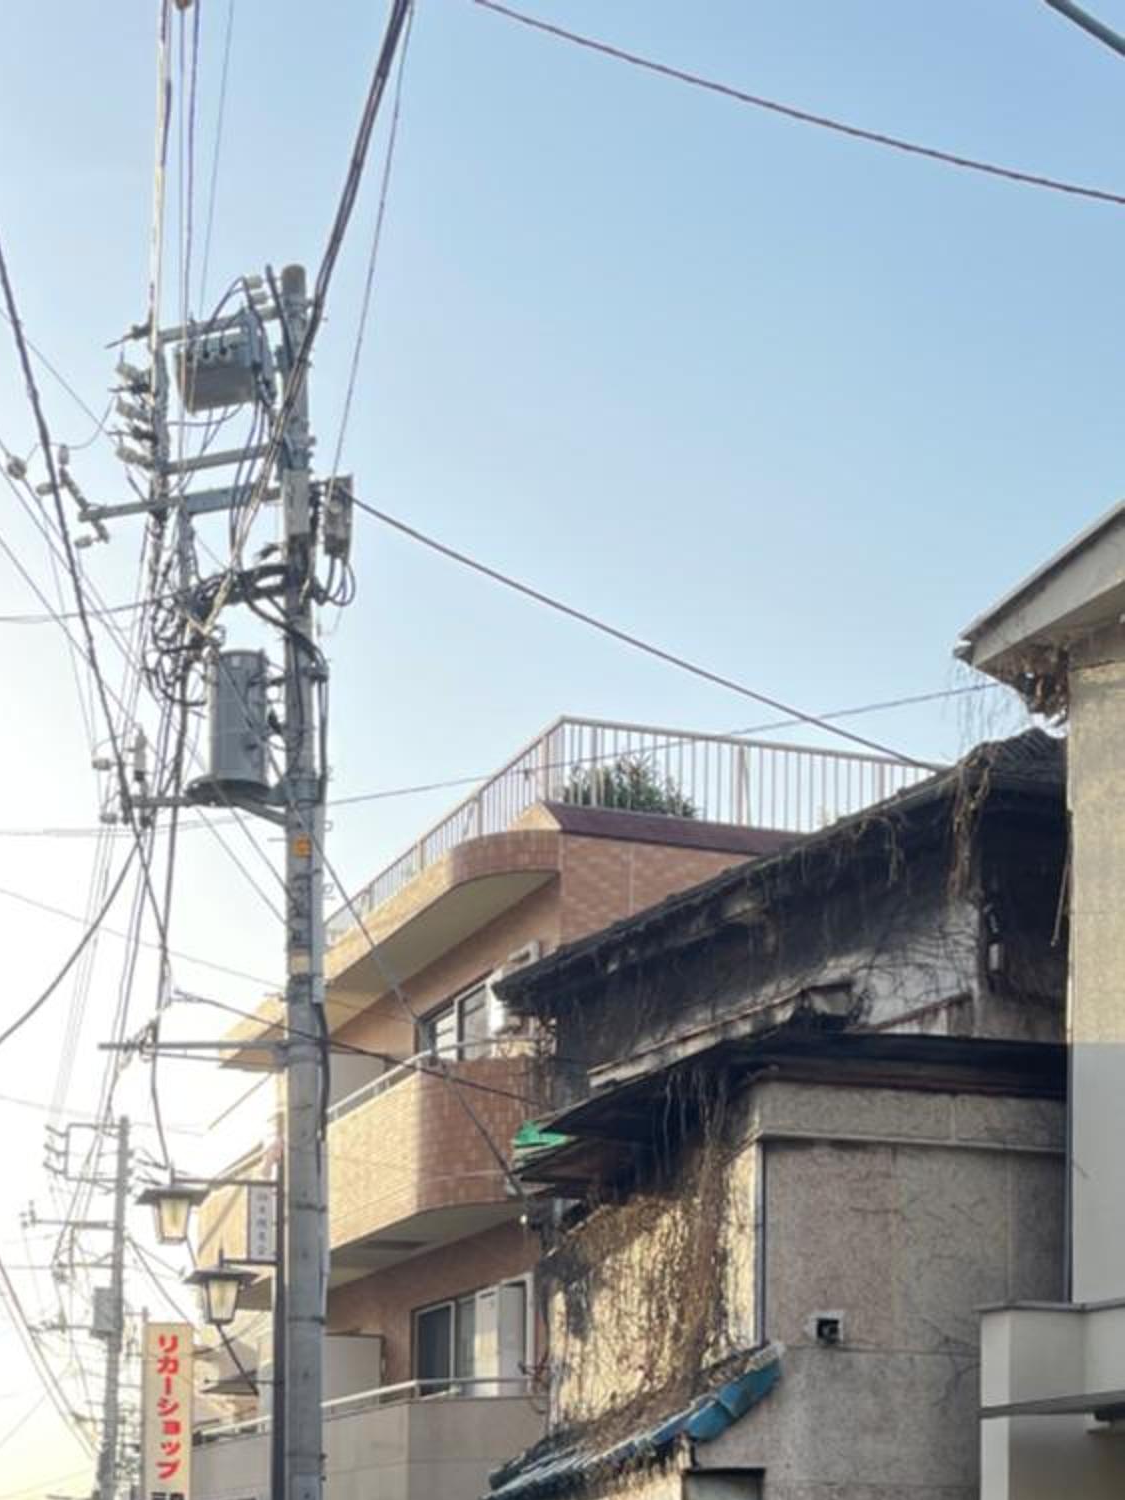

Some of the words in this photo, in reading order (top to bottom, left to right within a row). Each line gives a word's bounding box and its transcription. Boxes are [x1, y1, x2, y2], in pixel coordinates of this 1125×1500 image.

[156, 1334, 181, 1479] リカーショップ
